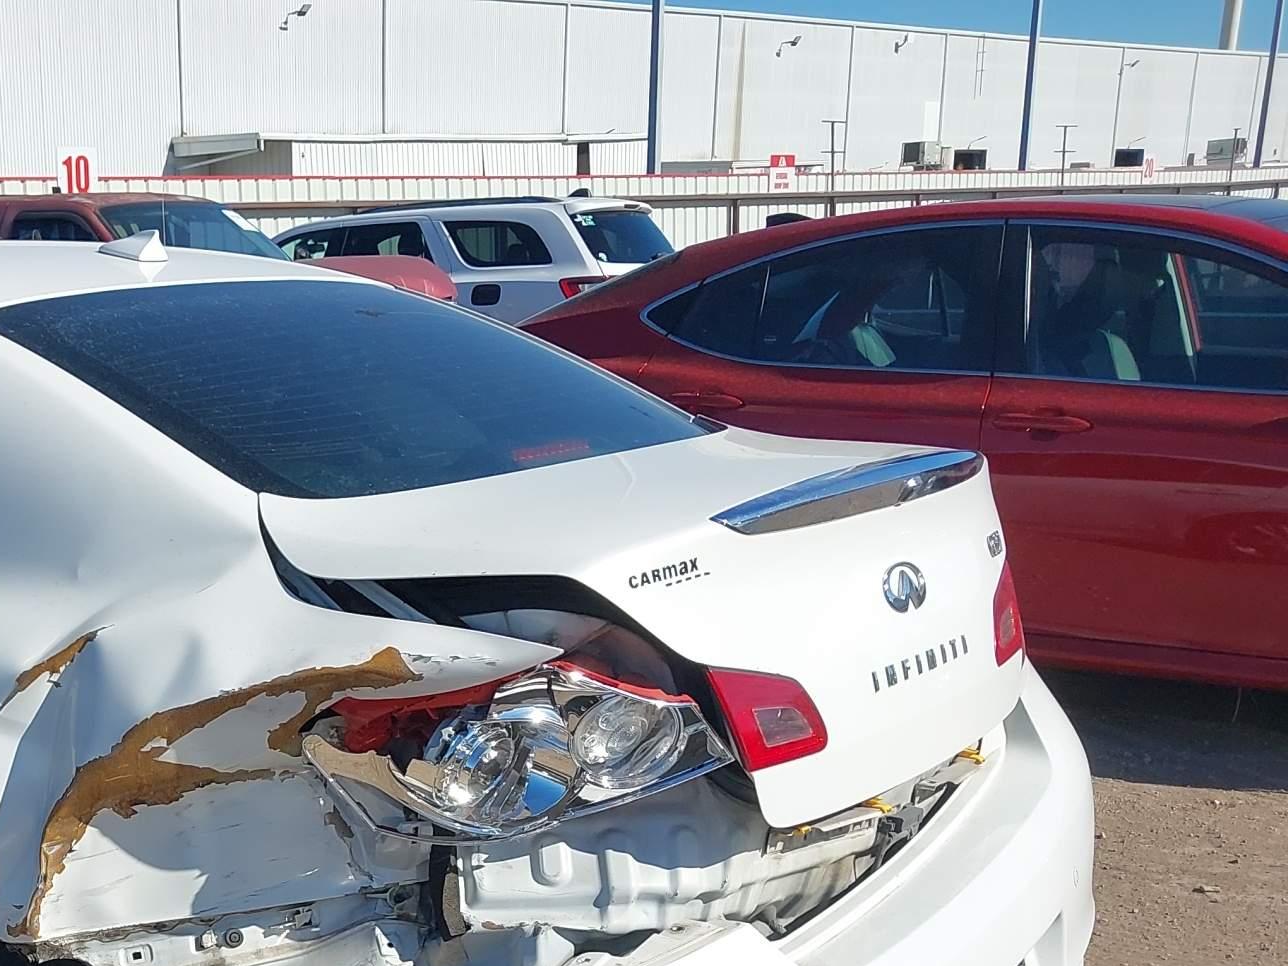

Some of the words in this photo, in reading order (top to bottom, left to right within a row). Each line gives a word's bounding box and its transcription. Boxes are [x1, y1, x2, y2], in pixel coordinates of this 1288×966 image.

[62, 155, 90, 194] 10
[1144, 158, 1154, 178] 20
[871, 635, 968, 693] INFINITI
